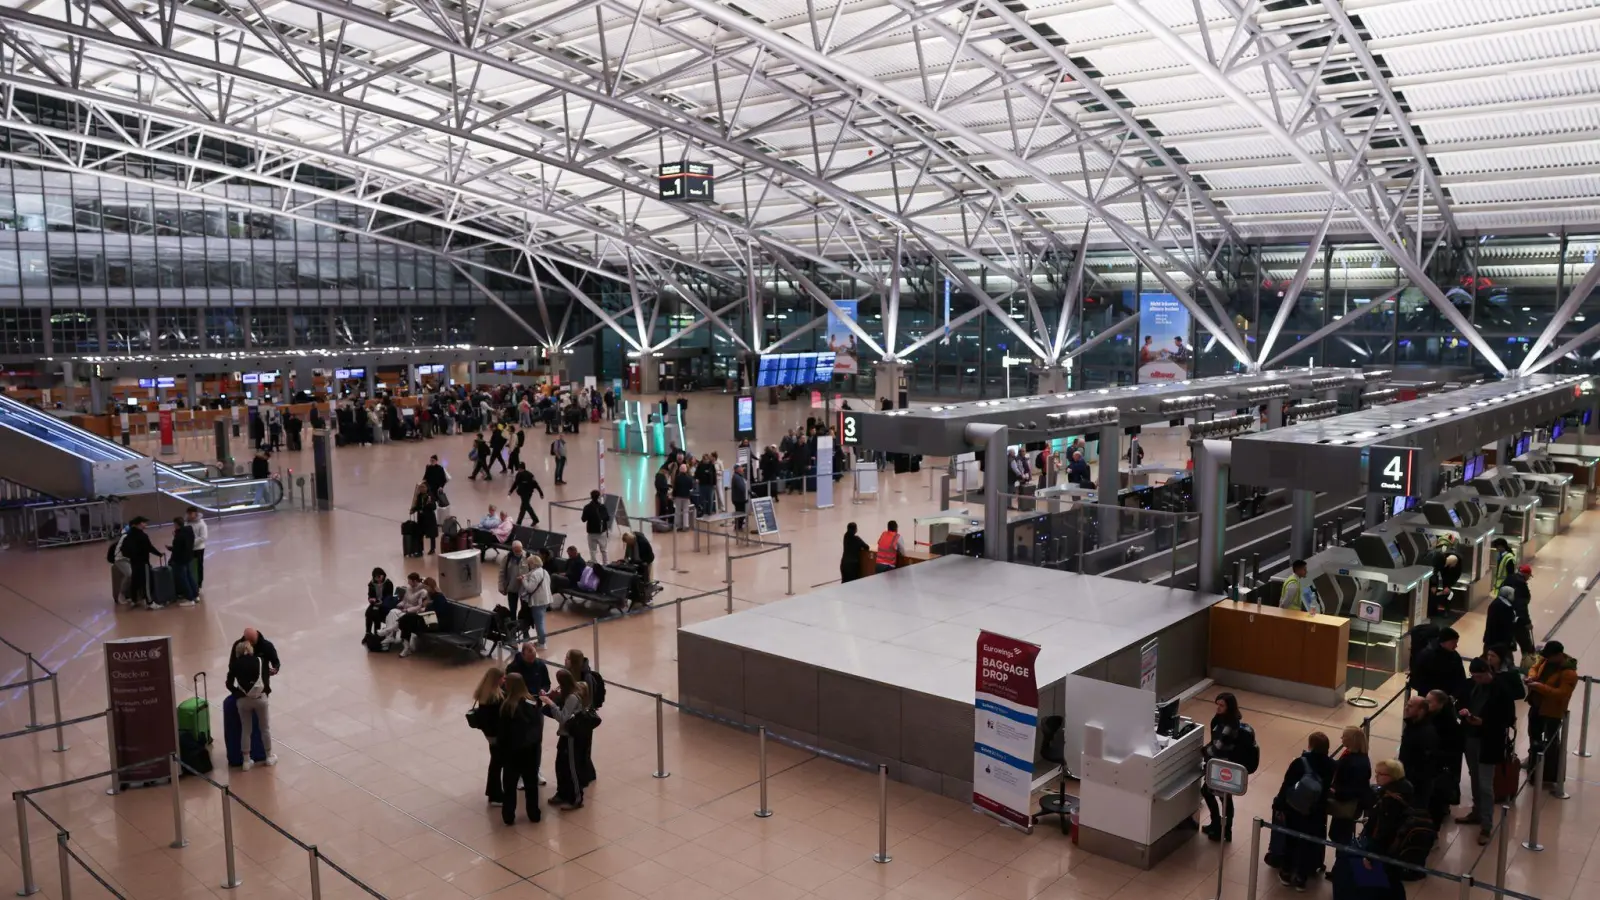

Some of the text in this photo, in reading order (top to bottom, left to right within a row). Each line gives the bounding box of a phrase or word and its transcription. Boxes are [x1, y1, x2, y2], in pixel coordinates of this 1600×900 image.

[674, 178, 681, 194] 1
[703, 180, 709, 195] 1
[844, 416, 856, 436] 3
[1383, 455, 1403, 481] 4
[112, 650, 148, 660] QATAR
[983, 644, 1014, 659] Eurowings
[112, 670, 149, 678] Check-in
[982, 657, 1029, 678] BAGGAGE
[982, 668, 1009, 682] DROP
